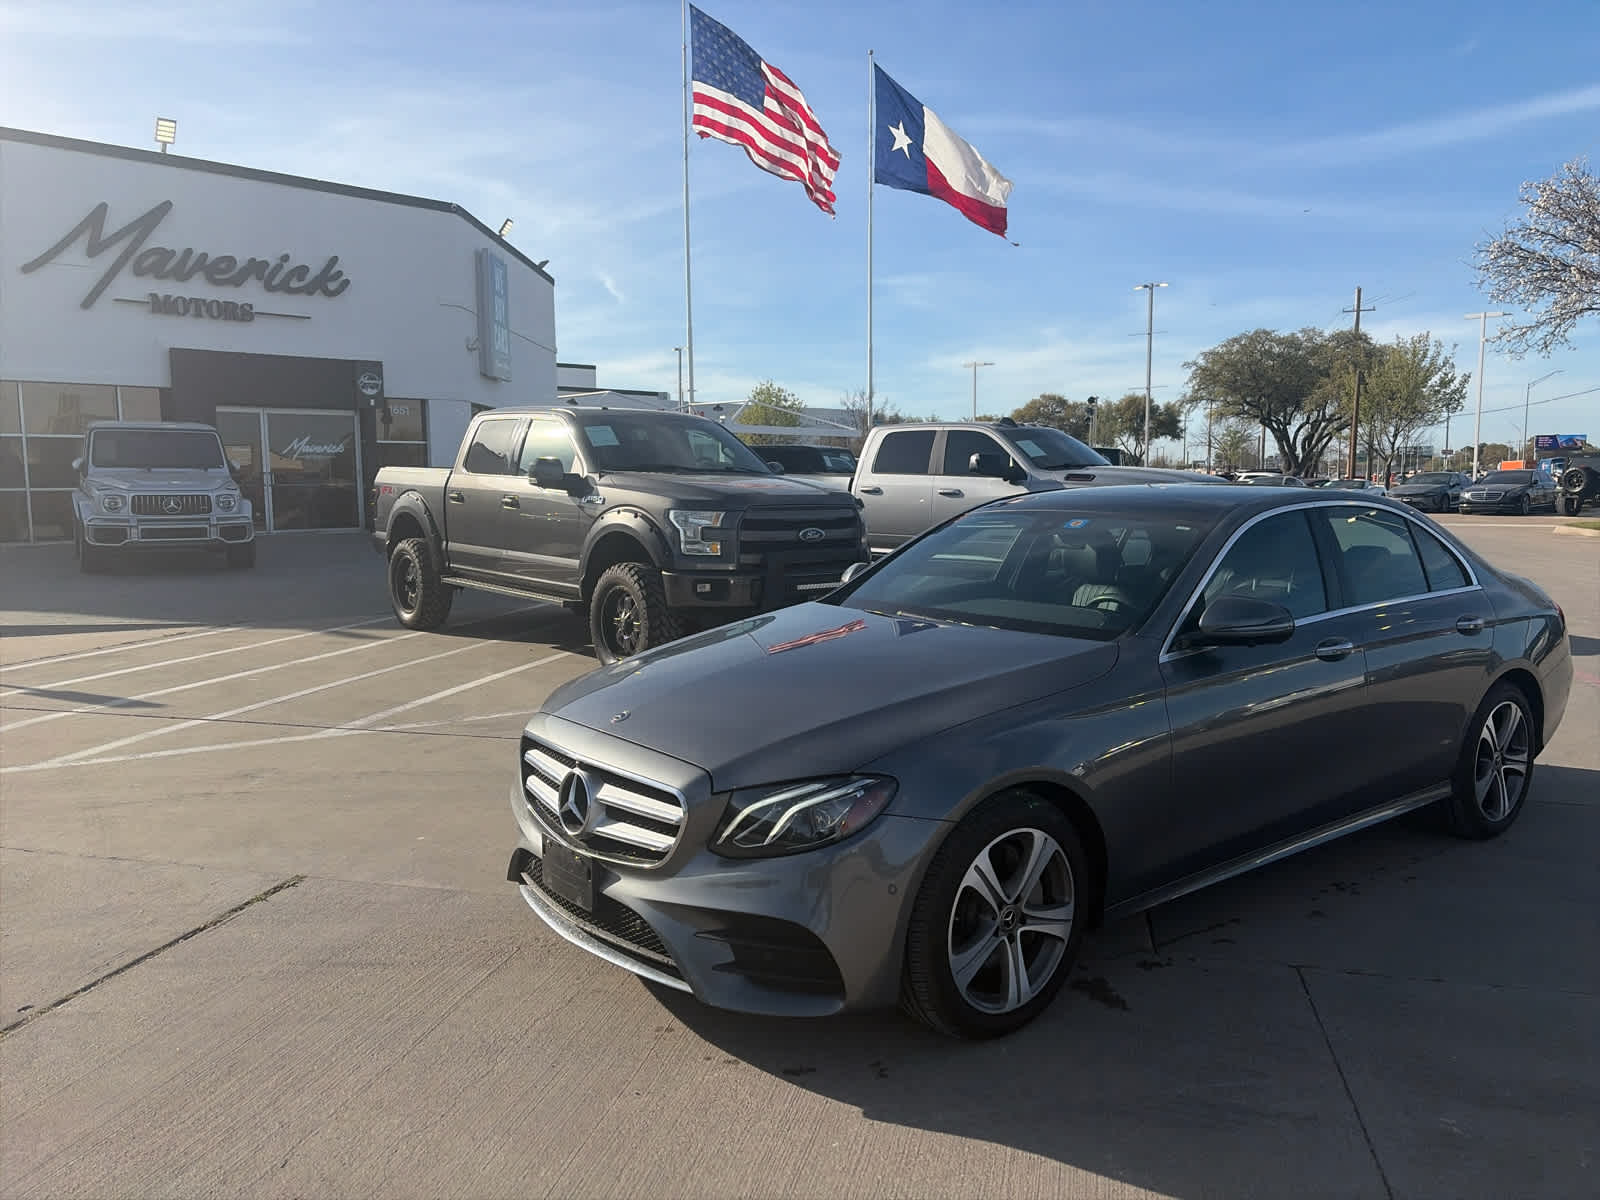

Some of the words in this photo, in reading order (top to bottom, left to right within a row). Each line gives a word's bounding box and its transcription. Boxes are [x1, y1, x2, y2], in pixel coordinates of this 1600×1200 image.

[21, 199, 350, 309] Maverick
[149, 294, 255, 322] MOTORS
[282, 435, 344, 461] Maverick
